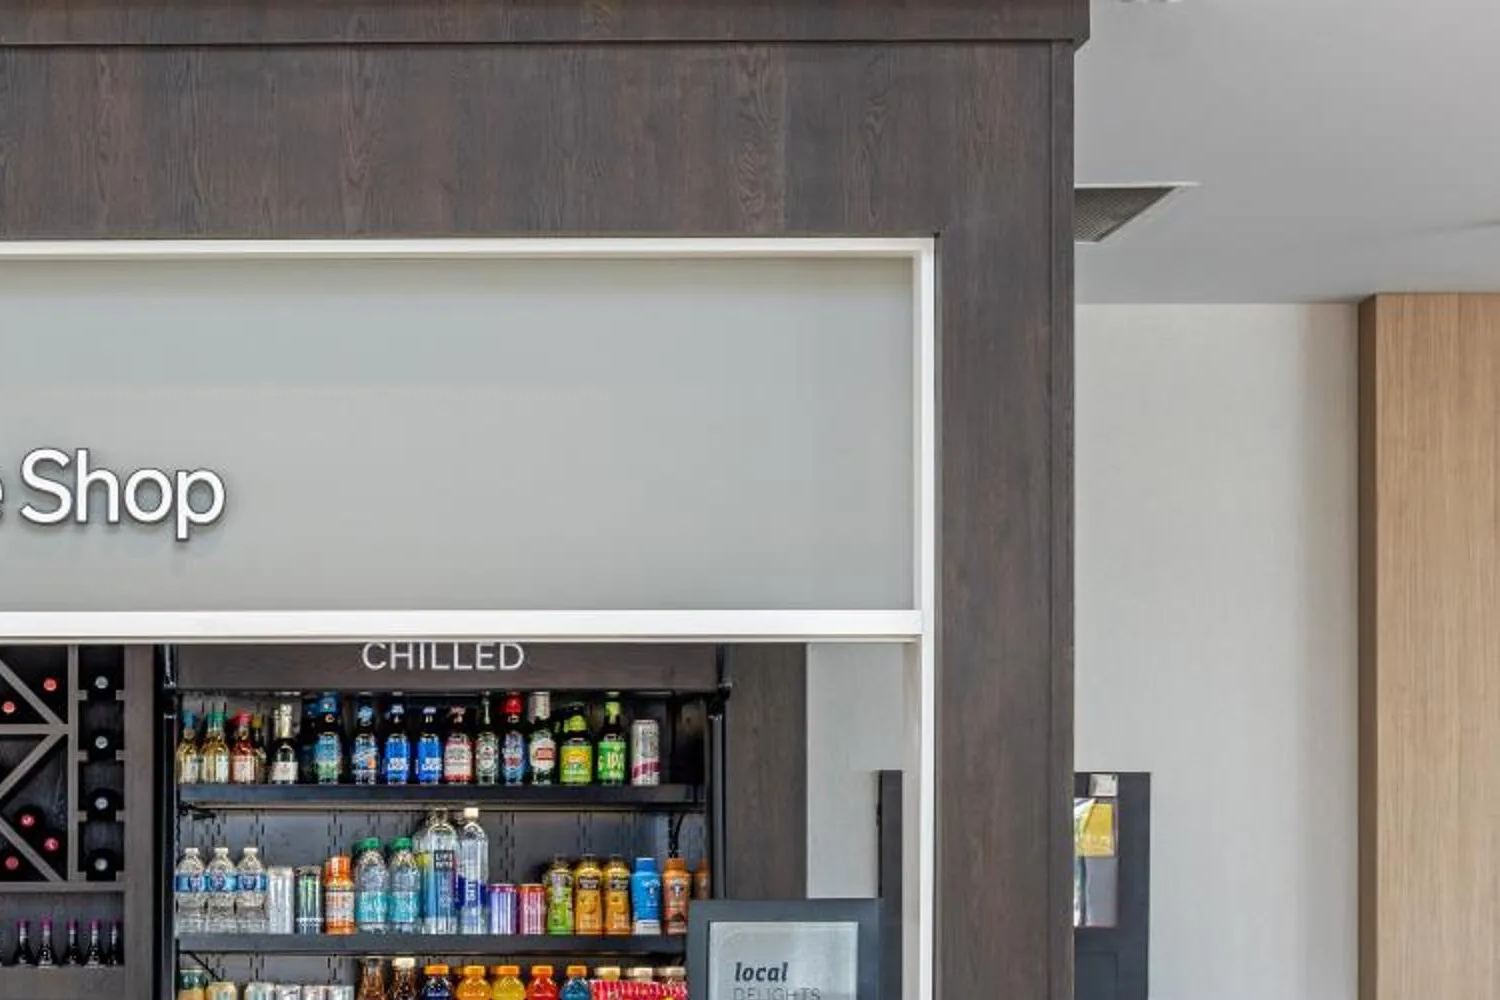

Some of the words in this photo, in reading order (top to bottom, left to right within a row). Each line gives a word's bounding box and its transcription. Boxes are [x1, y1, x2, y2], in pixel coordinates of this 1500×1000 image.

[20, 448, 227, 542] Shop
[361, 641, 525, 671] CHILLED
[734, 962, 789, 983] local
